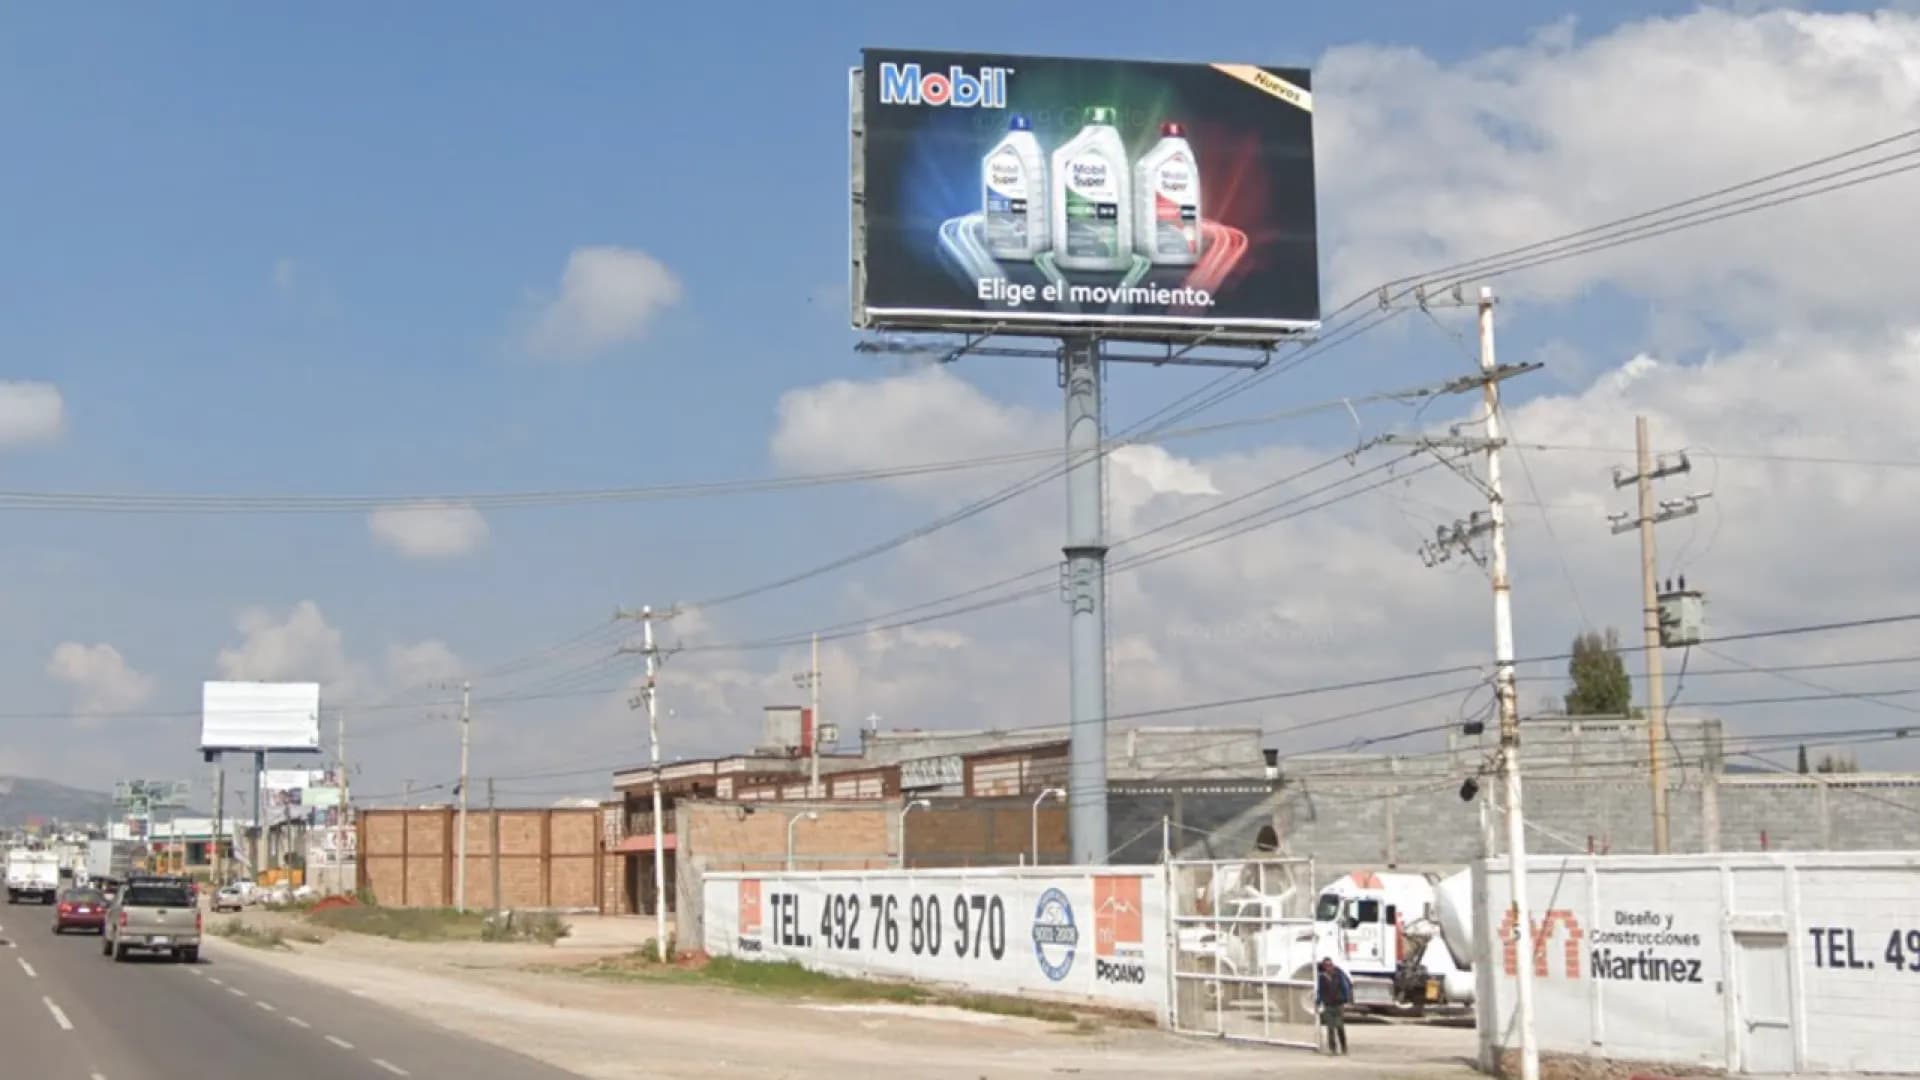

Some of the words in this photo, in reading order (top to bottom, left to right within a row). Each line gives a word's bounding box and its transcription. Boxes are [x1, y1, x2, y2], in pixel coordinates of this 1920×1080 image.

[879, 62, 1008, 108] Mobil
[1252, 71, 1302, 103] Nuevos
[1072, 163, 1106, 175] Mobil
[1072, 175, 1106, 188] Super
[977, 278, 1036, 307] Elige
[1042, 280, 1062, 302] el
[1069, 282, 1216, 307] movimiento.
[770, 893, 812, 948] TEL.
[820, 893, 860, 950] 492
[870, 893, 899, 953] 76
[910, 893, 942, 957] 80
[953, 894, 1006, 960] 970
[1614, 910, 1660, 926] Diseño
[1665, 914, 1674, 930] y
[1590, 930, 1701, 947] Construcciones
[1809, 927, 1874, 970] TEL.
[1590, 947, 1703, 983] Martínez
